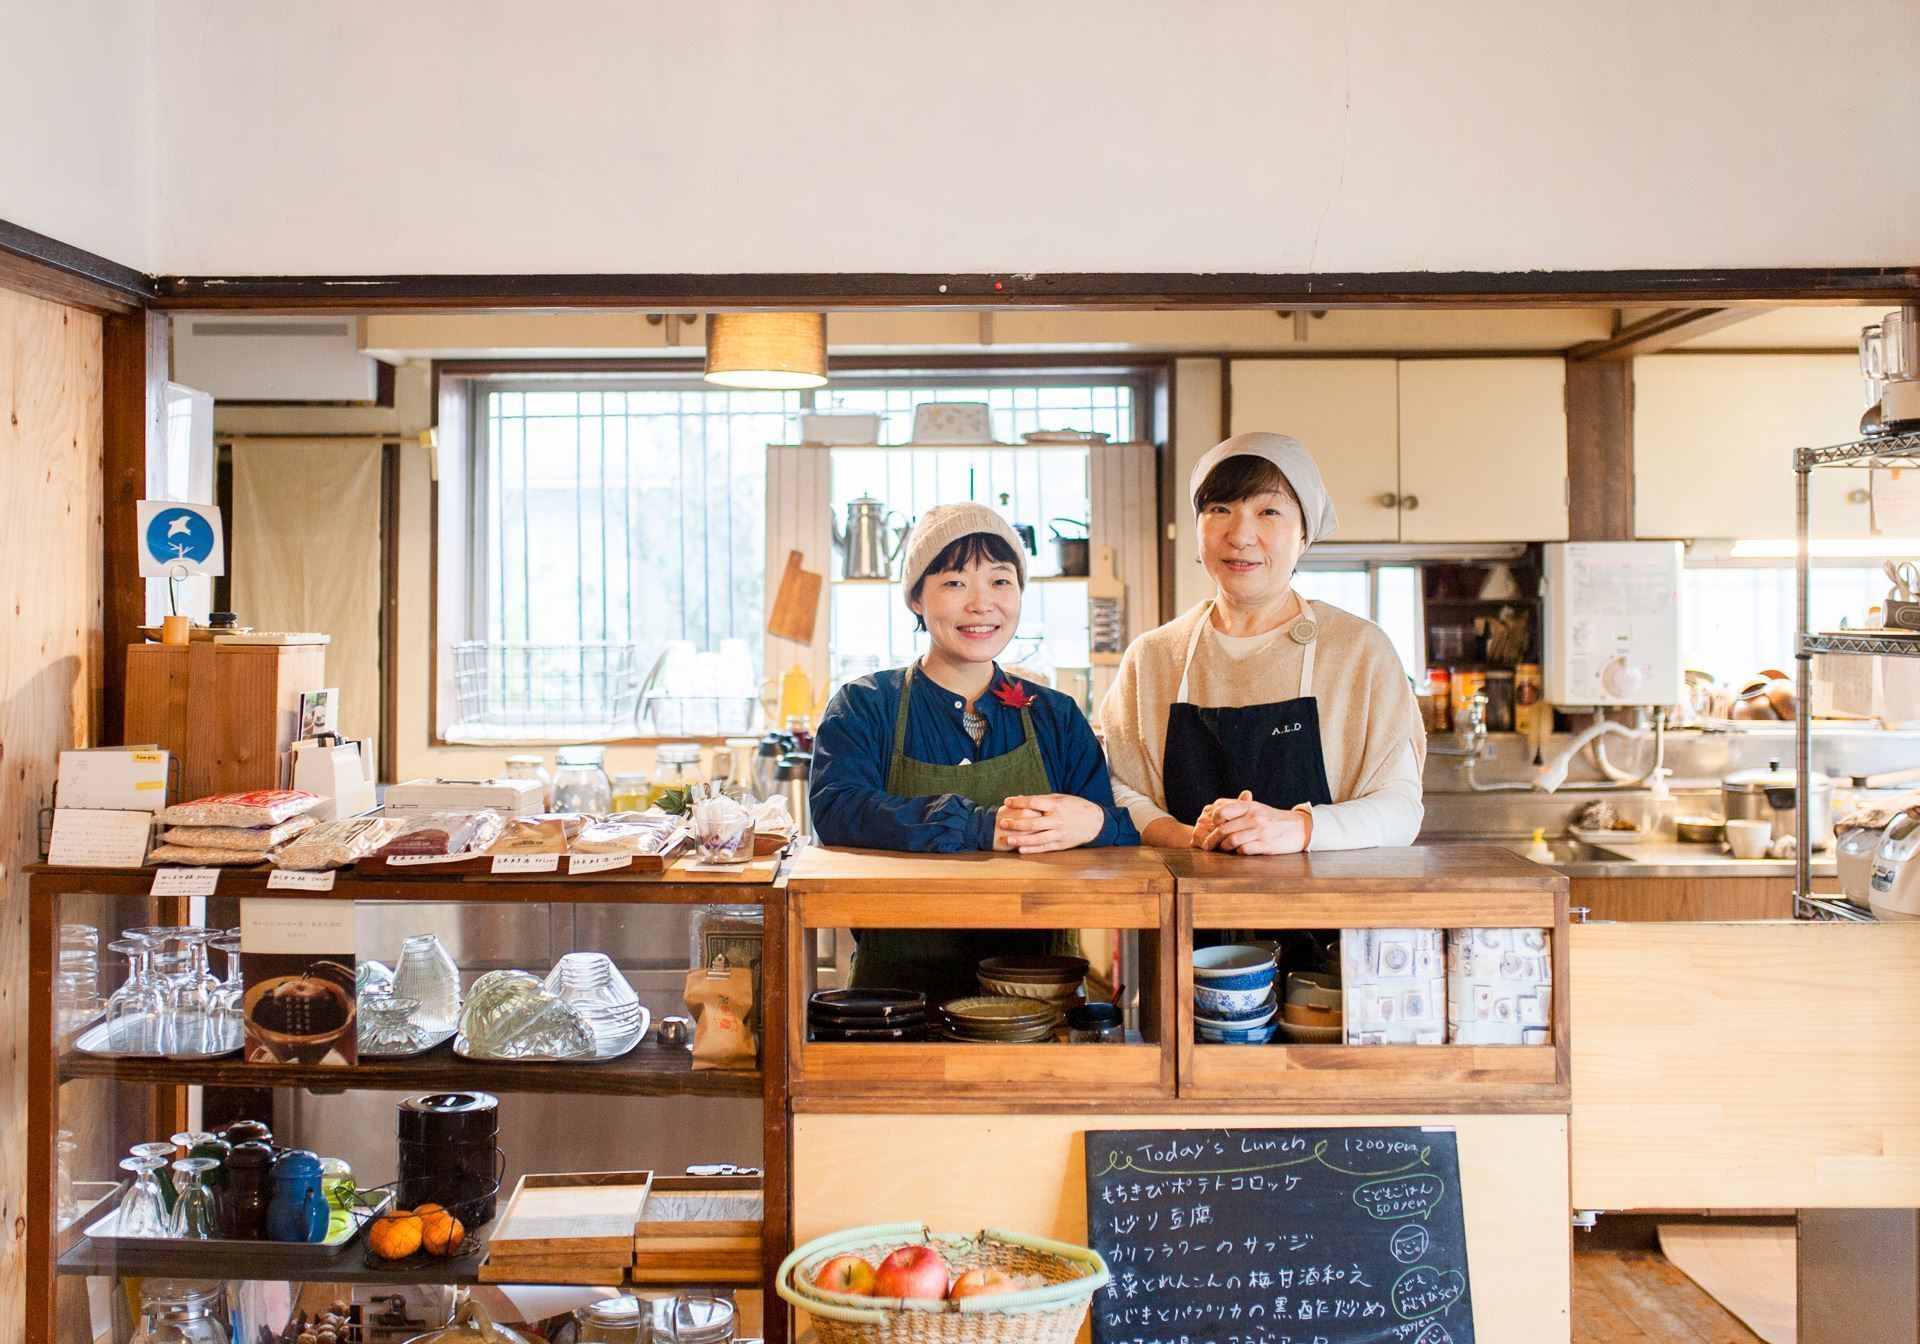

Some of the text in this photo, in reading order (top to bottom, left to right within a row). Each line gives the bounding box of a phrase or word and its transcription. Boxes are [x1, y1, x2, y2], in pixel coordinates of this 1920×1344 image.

[1137, 1138, 1224, 1162] Today's
[1241, 1134, 1306, 1154] Lunch
[1102, 1174, 1302, 1205] もちきびポテトコロッケ
[1362, 1182, 1434, 1202] こどもごはん
[1108, 1203, 1214, 1235] 炒り豆腐
[1376, 1199, 1427, 1216] 500yen
[1108, 1234, 1314, 1263] カリフラワーのサブジ
[1398, 1274, 1427, 1295] こども
[1392, 1315, 1436, 1342] 350yen
